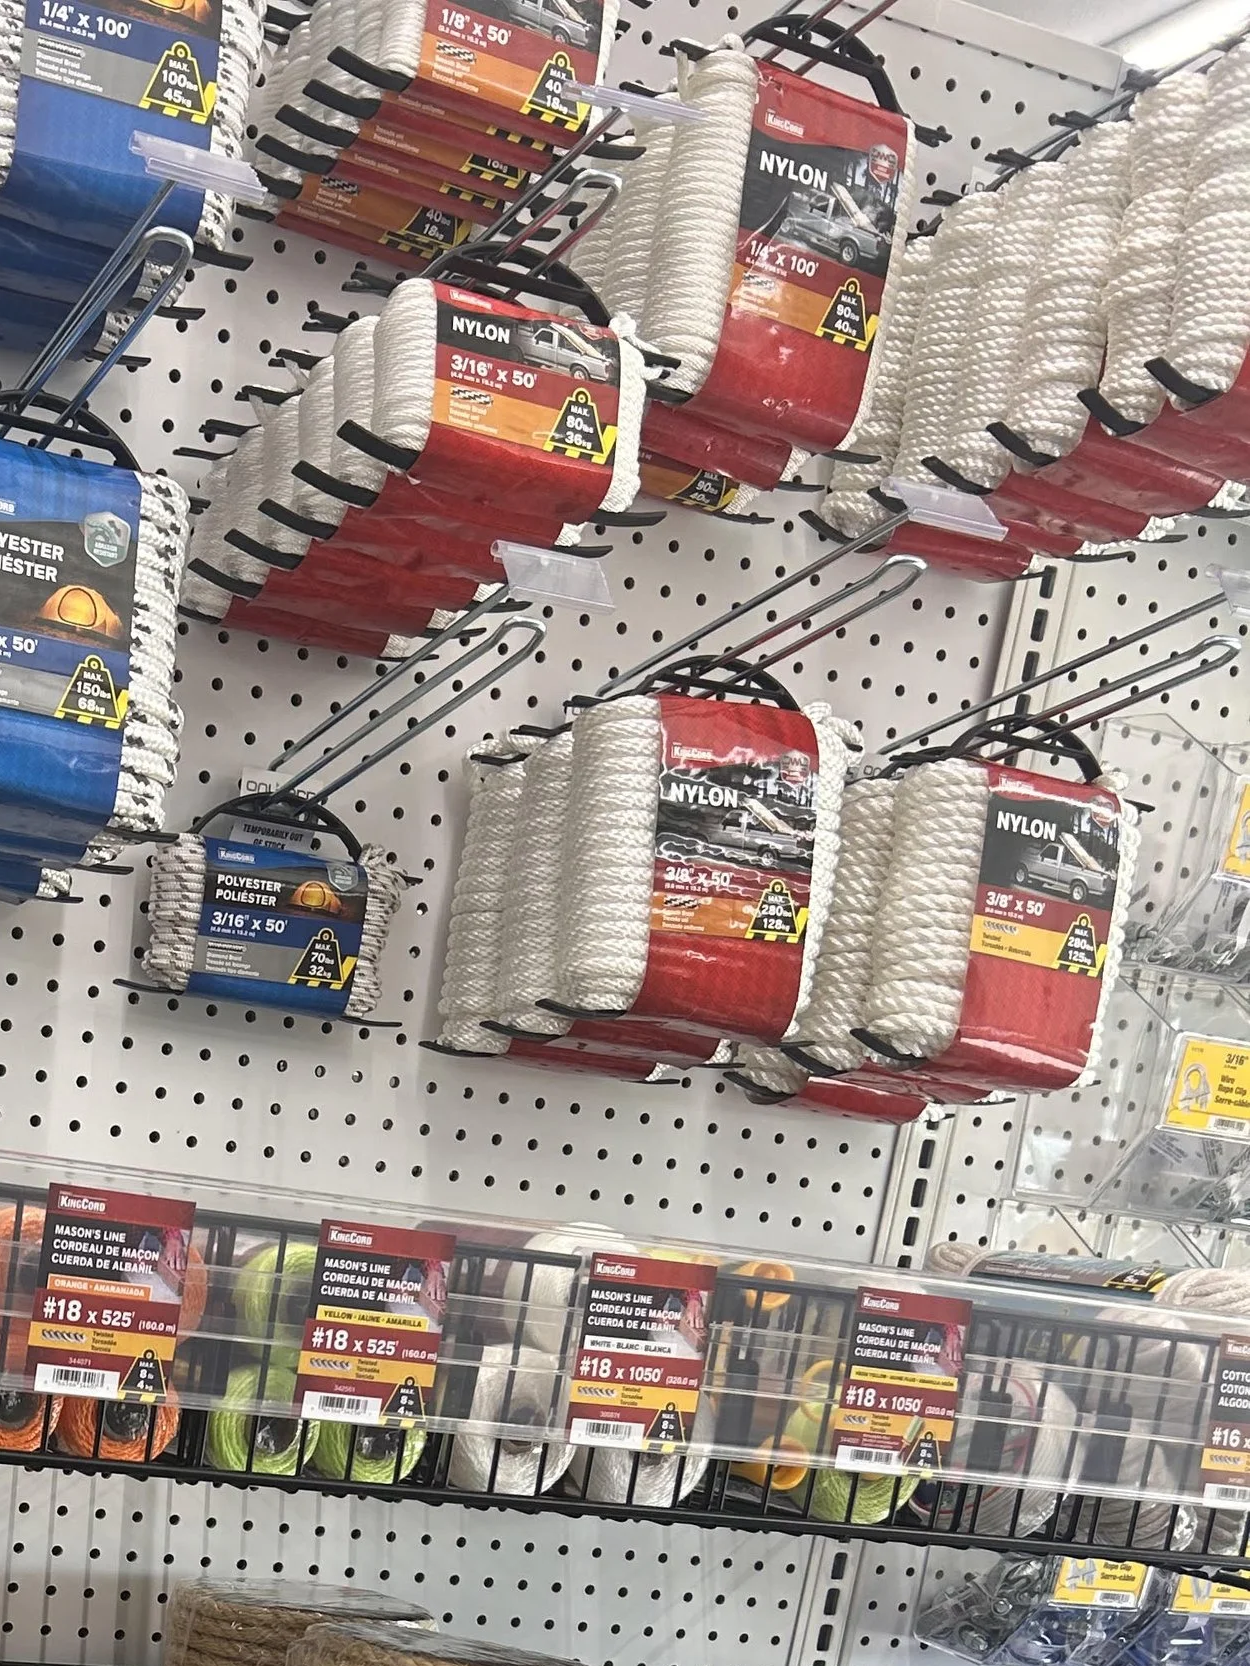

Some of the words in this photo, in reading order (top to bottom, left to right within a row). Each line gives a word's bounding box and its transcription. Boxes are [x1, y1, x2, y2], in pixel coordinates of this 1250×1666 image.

[441, 8, 471, 31] 1/8"
[472, 23, 484, 36] x
[487, 23, 512, 45] 50'
[169, 58, 190, 72] MAX.
[759, 151, 828, 191] NYLON
[452, 316, 510, 345] NYLON
[451, 355, 493, 377] 3/16"
[497, 370, 508, 381] x
[512, 372, 537, 389] 50'
[570, 405, 590, 417] MAX.
[12, 636, 38, 654] 50'
[83, 671, 104, 682] MAX.
[669, 783, 739, 808] NYLON
[996, 811, 1056, 841] NYLON
[217, 874, 281, 892] POLYESTER
[215, 890, 277, 906] POLIÉSTER
[985, 892, 1012, 909] 3/8"
[1014, 902, 1023, 912] x
[1026, 899, 1045, 916] 50'
[212, 912, 250, 927] 3/16"
[252, 920, 261, 930] x
[265, 919, 288, 933] 50'
[43, 1297, 82, 1322] #18
[87, 1313, 98, 1324] x
[101, 1310, 135, 1329] 525'
[579, 1356, 612, 1379] #18
[615, 1368, 625, 1381] x
[629, 1365, 663, 1384] 1050'
